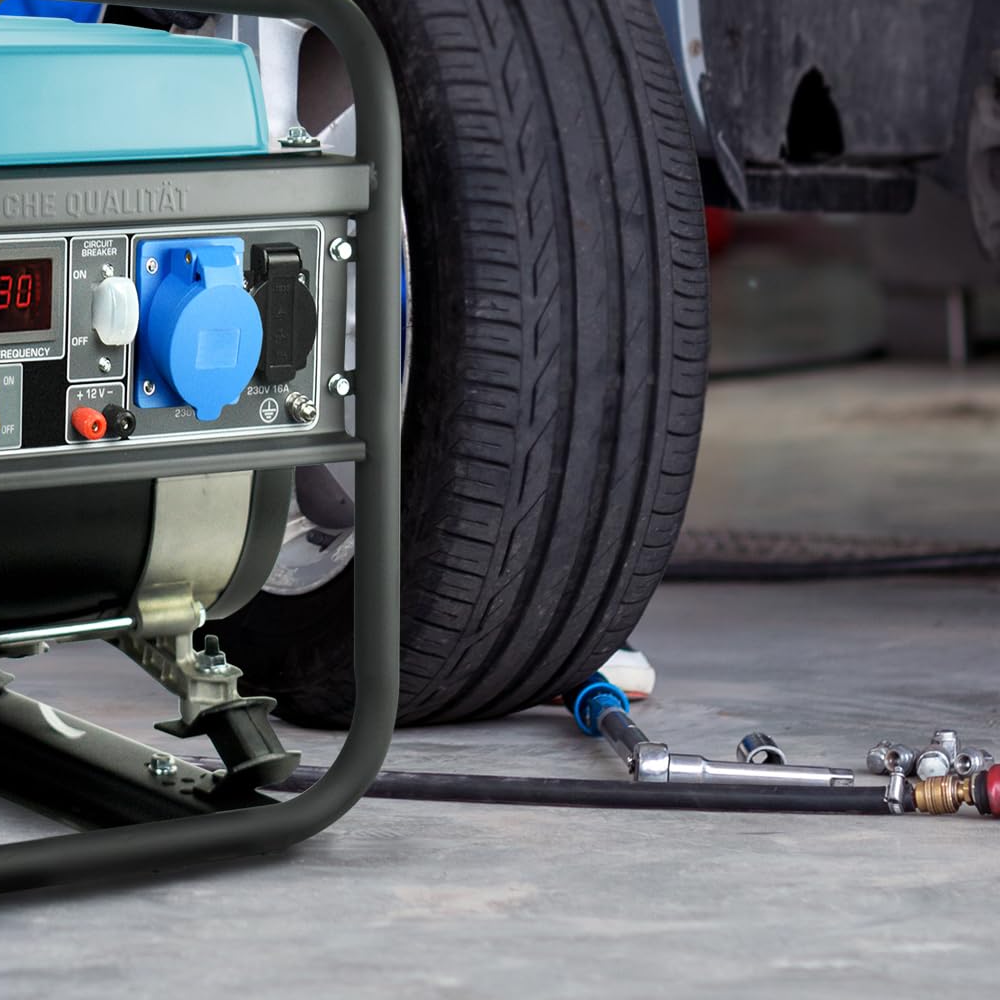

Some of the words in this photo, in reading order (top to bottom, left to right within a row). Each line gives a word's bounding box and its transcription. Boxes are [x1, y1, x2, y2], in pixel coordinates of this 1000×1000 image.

[64, 181, 189, 218] QUALITÄT
[83, 239, 114, 249] CIRCUIT
[81, 247, 118, 257] BREAKER
[72, 269, 87, 279] ON
[71, 336, 89, 347] OFF
[3, 375, 15, 386] ON
[87, 388, 97, 399] 12
[99, 388, 105, 398] V
[247, 385, 271, 396] 230V
[273, 384, 290, 394] 16A
[1, 424, 15, 434] OFF
